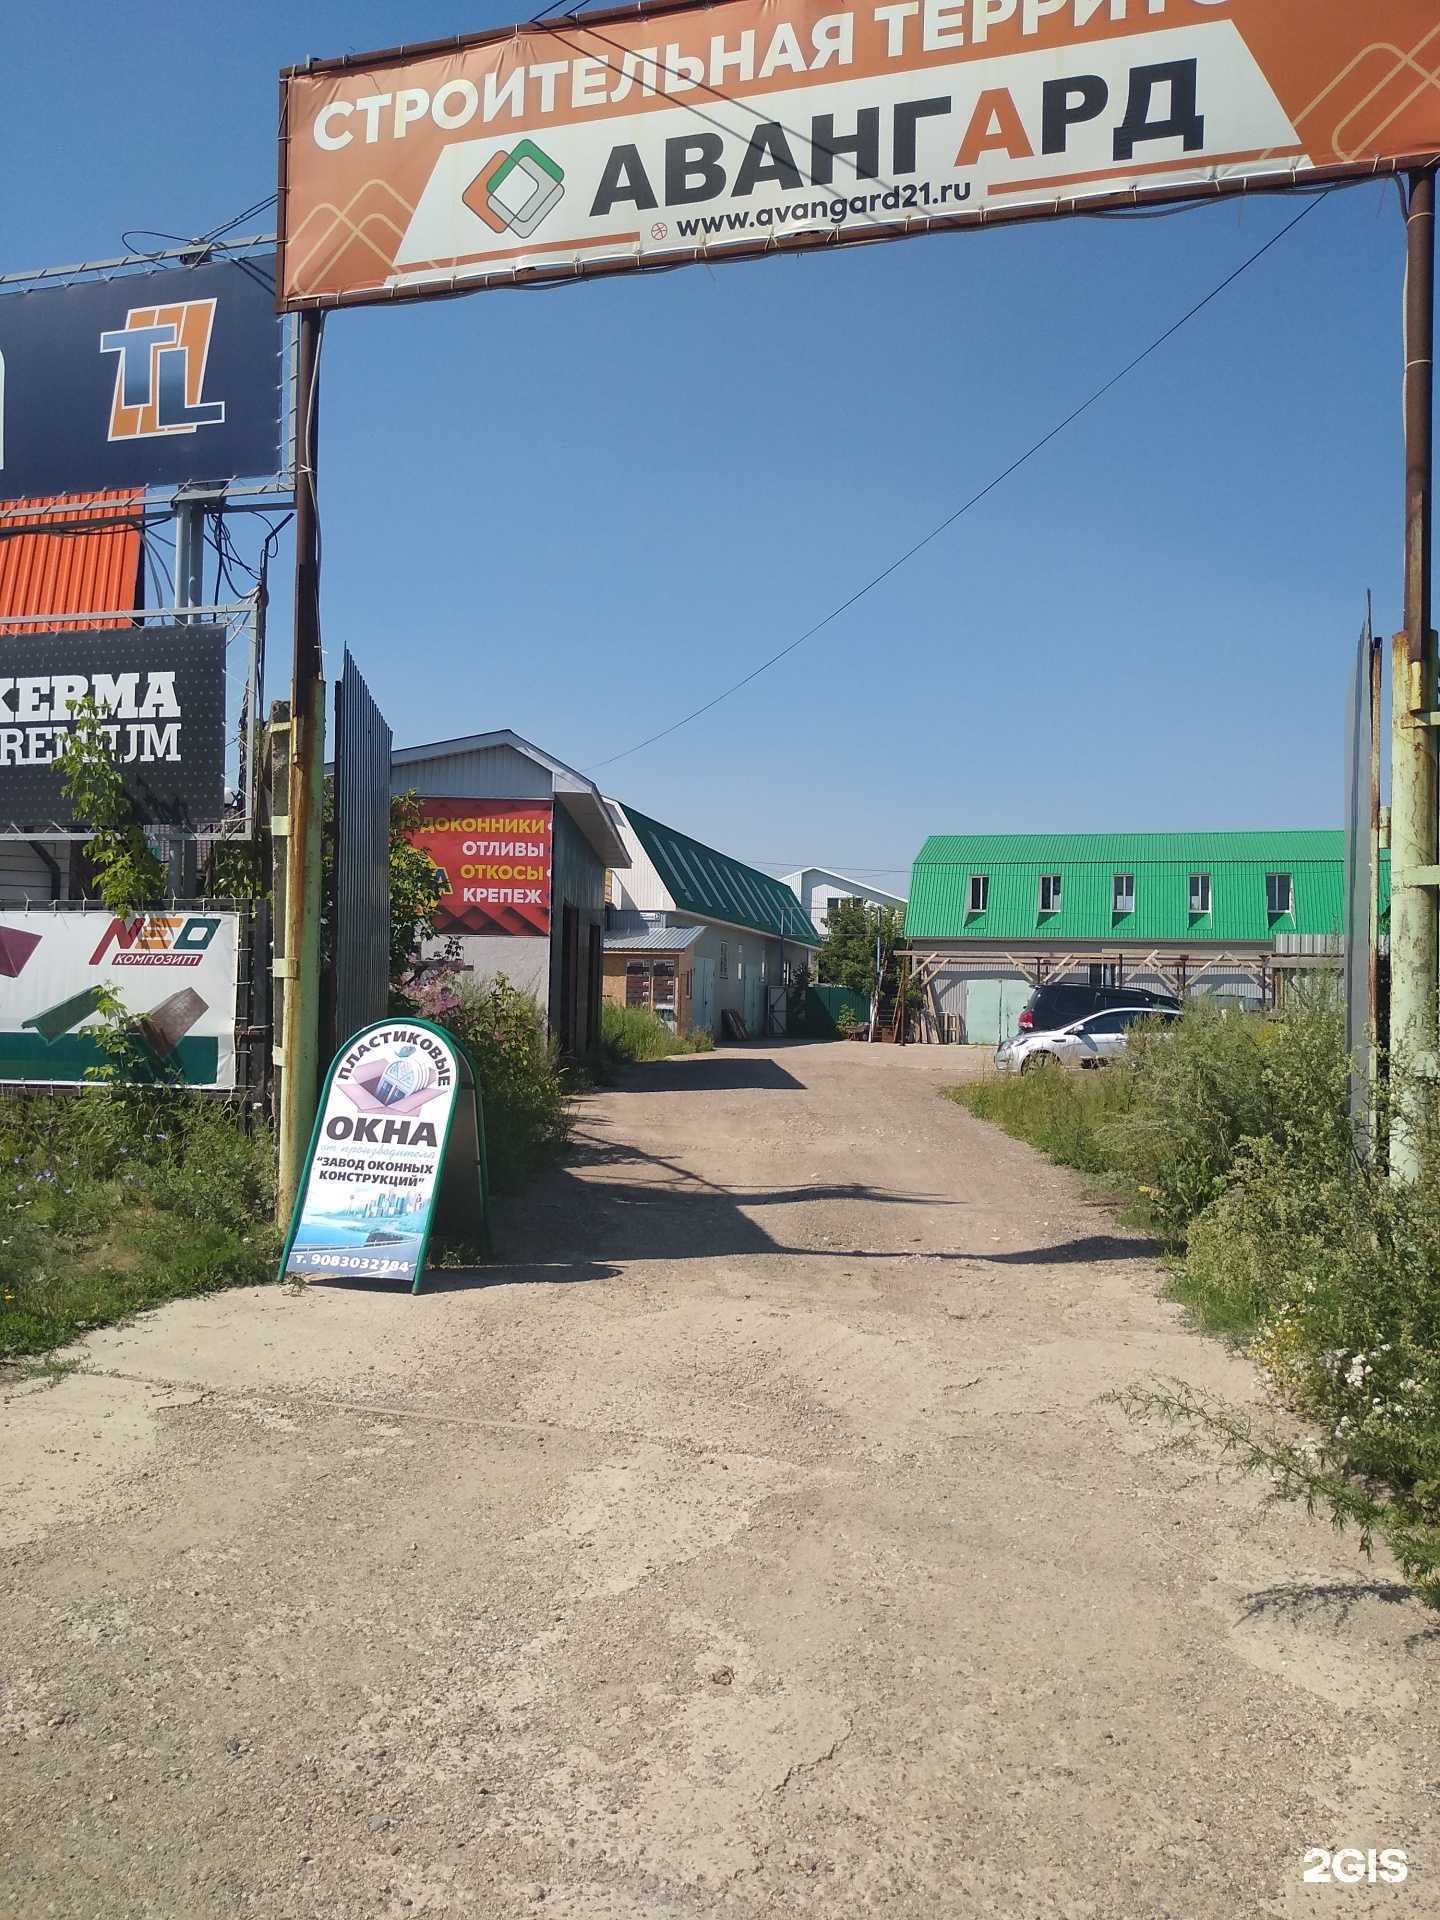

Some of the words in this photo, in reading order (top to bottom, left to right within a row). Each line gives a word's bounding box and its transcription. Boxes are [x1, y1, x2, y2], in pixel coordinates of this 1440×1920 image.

[313, 12, 855, 152] СТРОИТЕЛЬНАЯ
[589, 58, 1205, 218] АВАНГАРД
[677, 181, 971, 238] www.avangard21.ru
[462, 841, 544, 857] ОТЛИВЫ
[460, 864, 544, 881] ОТКОСЫ
[463, 887, 542, 904] КРЕПЕЖ
[89, 917, 222, 966] NEO
[338, 1030, 451, 1087] ПЛАСТИКОВЫЕ
[326, 1116, 438, 1147] ОКНА
[367, 1160, 434, 1175] ОКОННЫХ
